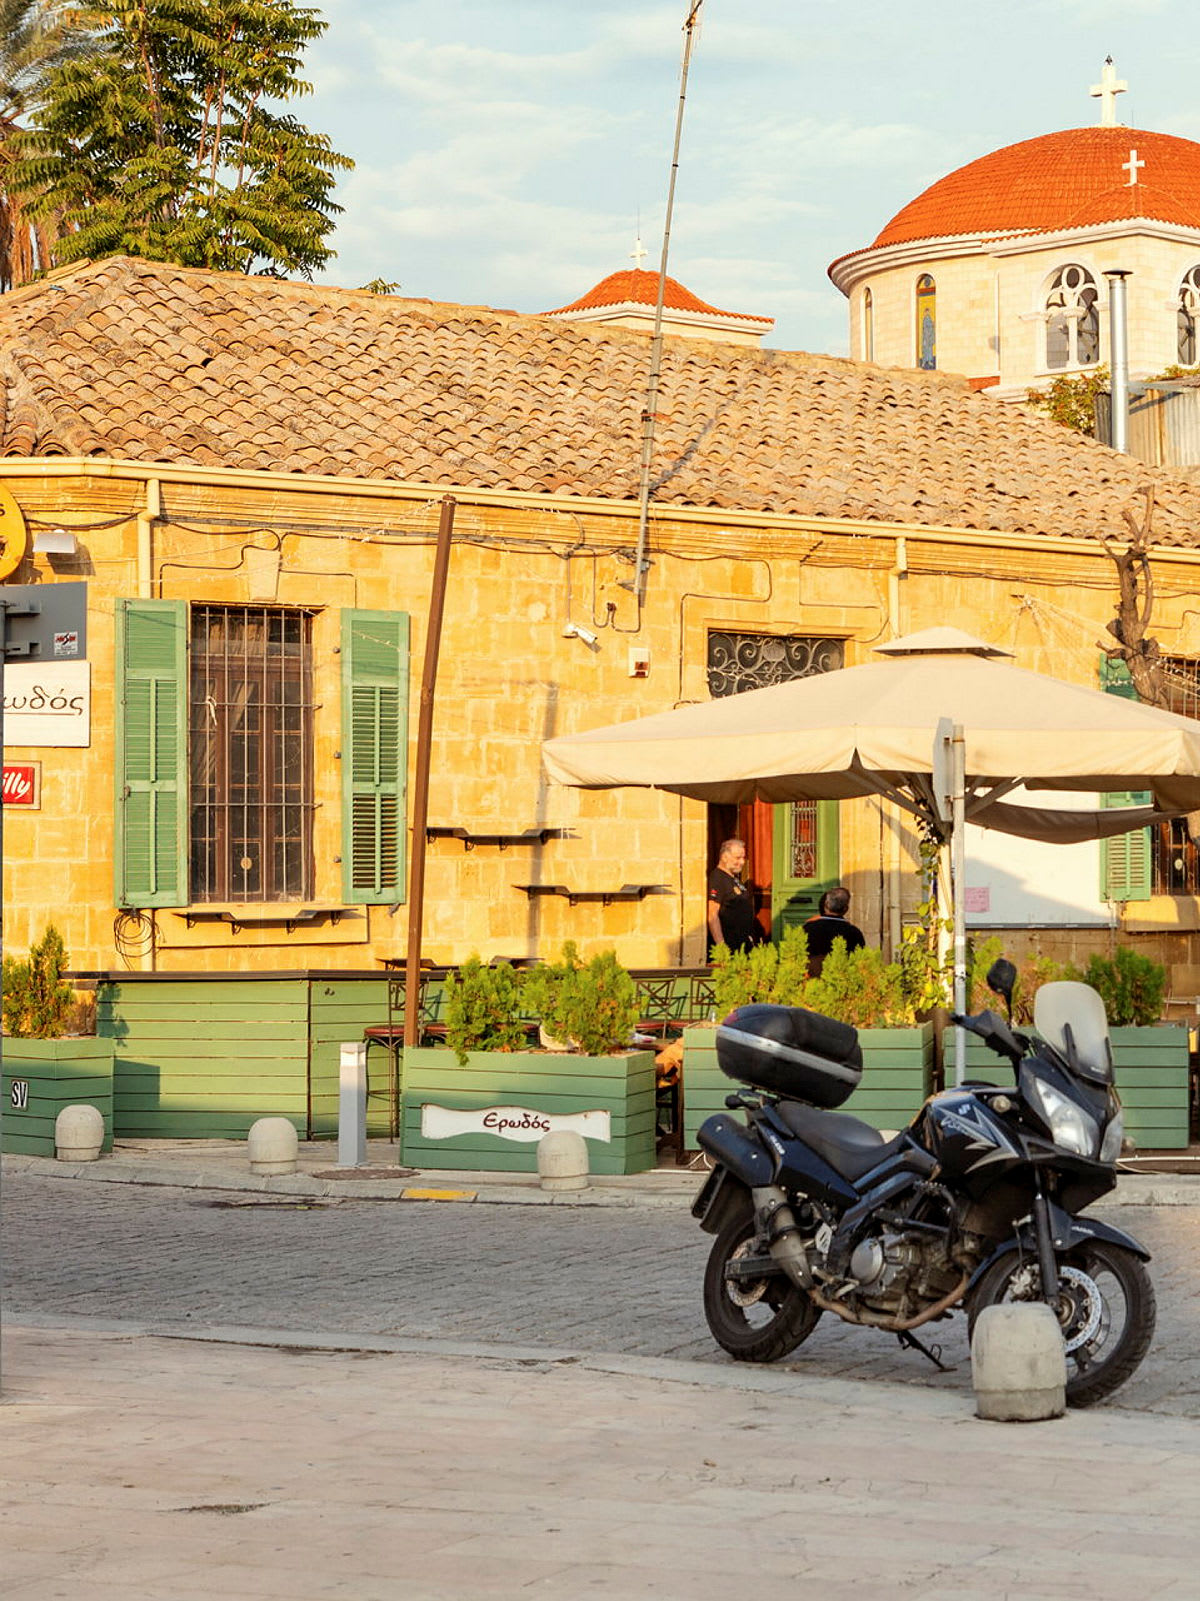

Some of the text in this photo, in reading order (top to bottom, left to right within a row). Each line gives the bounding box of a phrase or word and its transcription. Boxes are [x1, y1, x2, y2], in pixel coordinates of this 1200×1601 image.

[3, 771, 31, 800] illy
[11, 1082, 27, 1107] SV
[482, 1111, 551, 1133] Ερωδός
